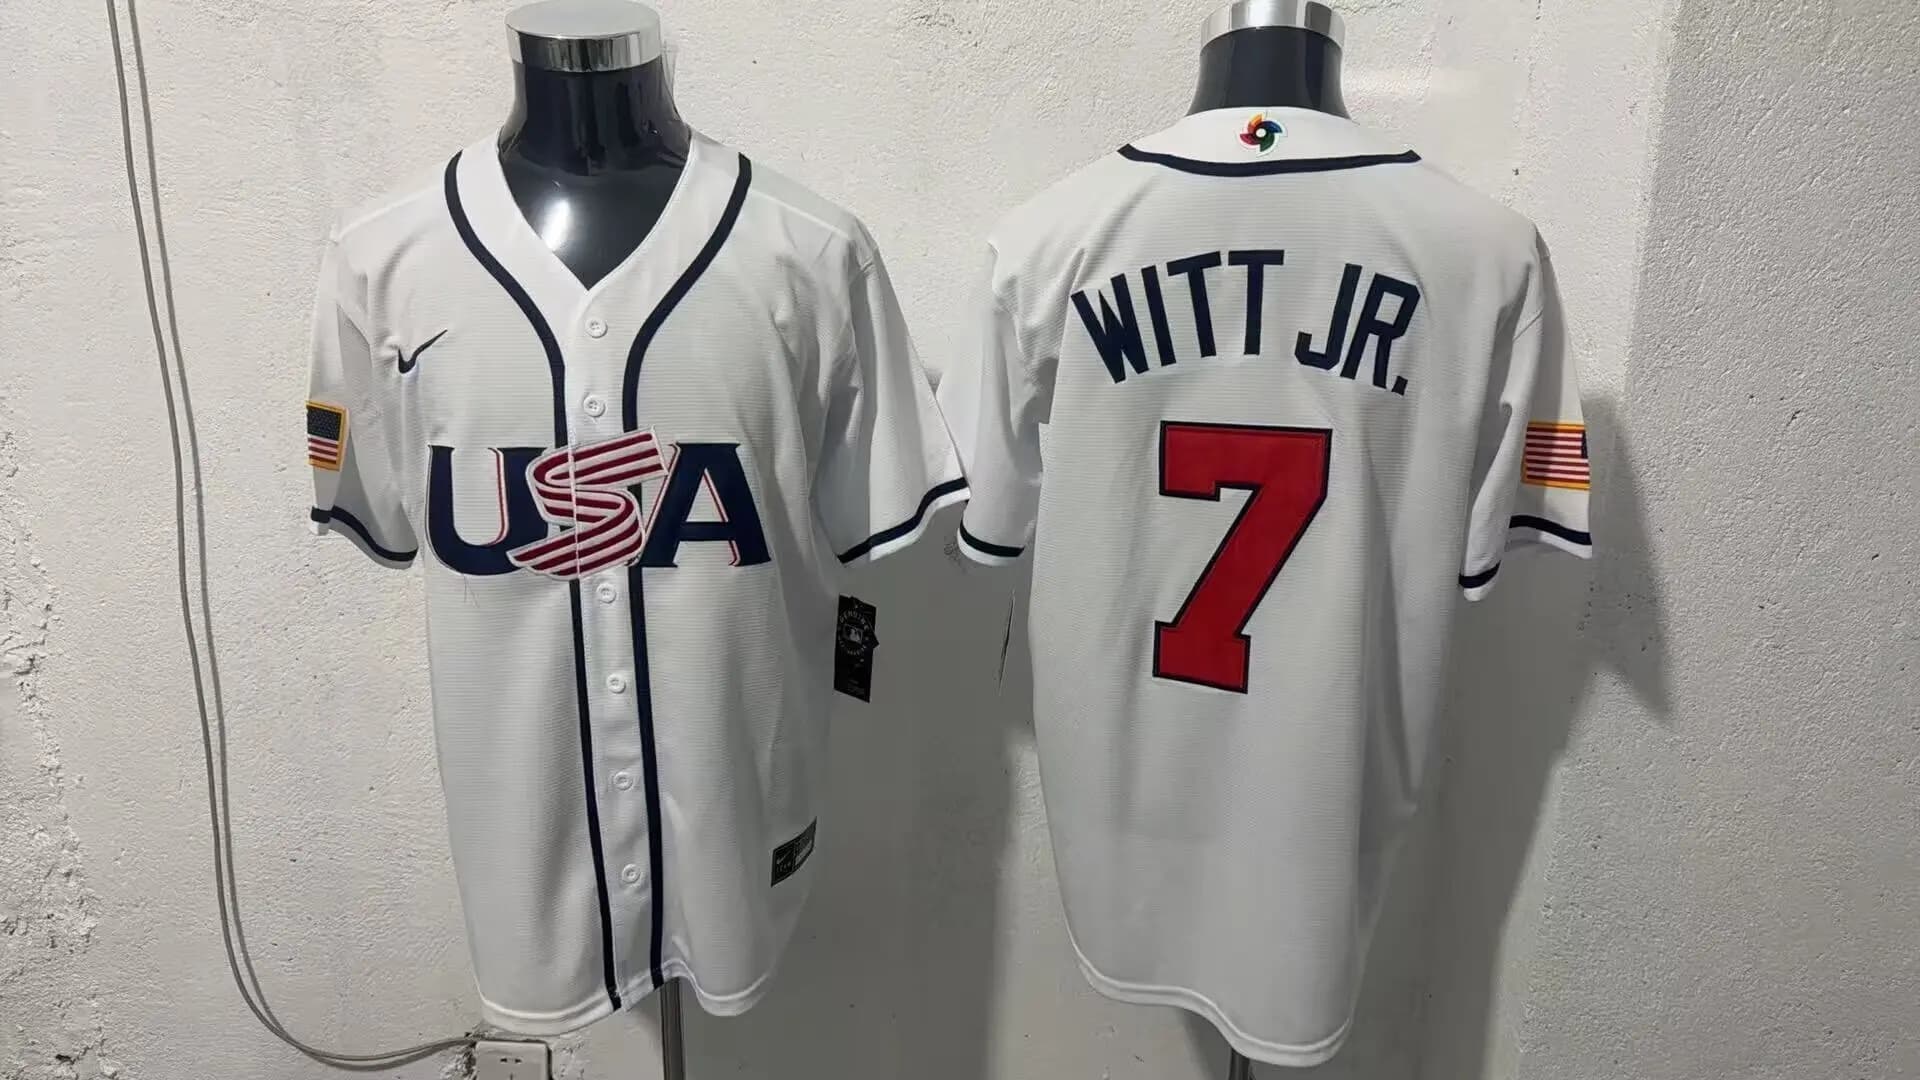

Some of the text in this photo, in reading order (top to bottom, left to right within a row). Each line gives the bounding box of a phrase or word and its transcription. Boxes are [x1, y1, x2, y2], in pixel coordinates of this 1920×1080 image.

[1071, 250, 1421, 396] WITT JR.
[426, 426, 771, 580] USA
[1152, 421, 1332, 694] 7
